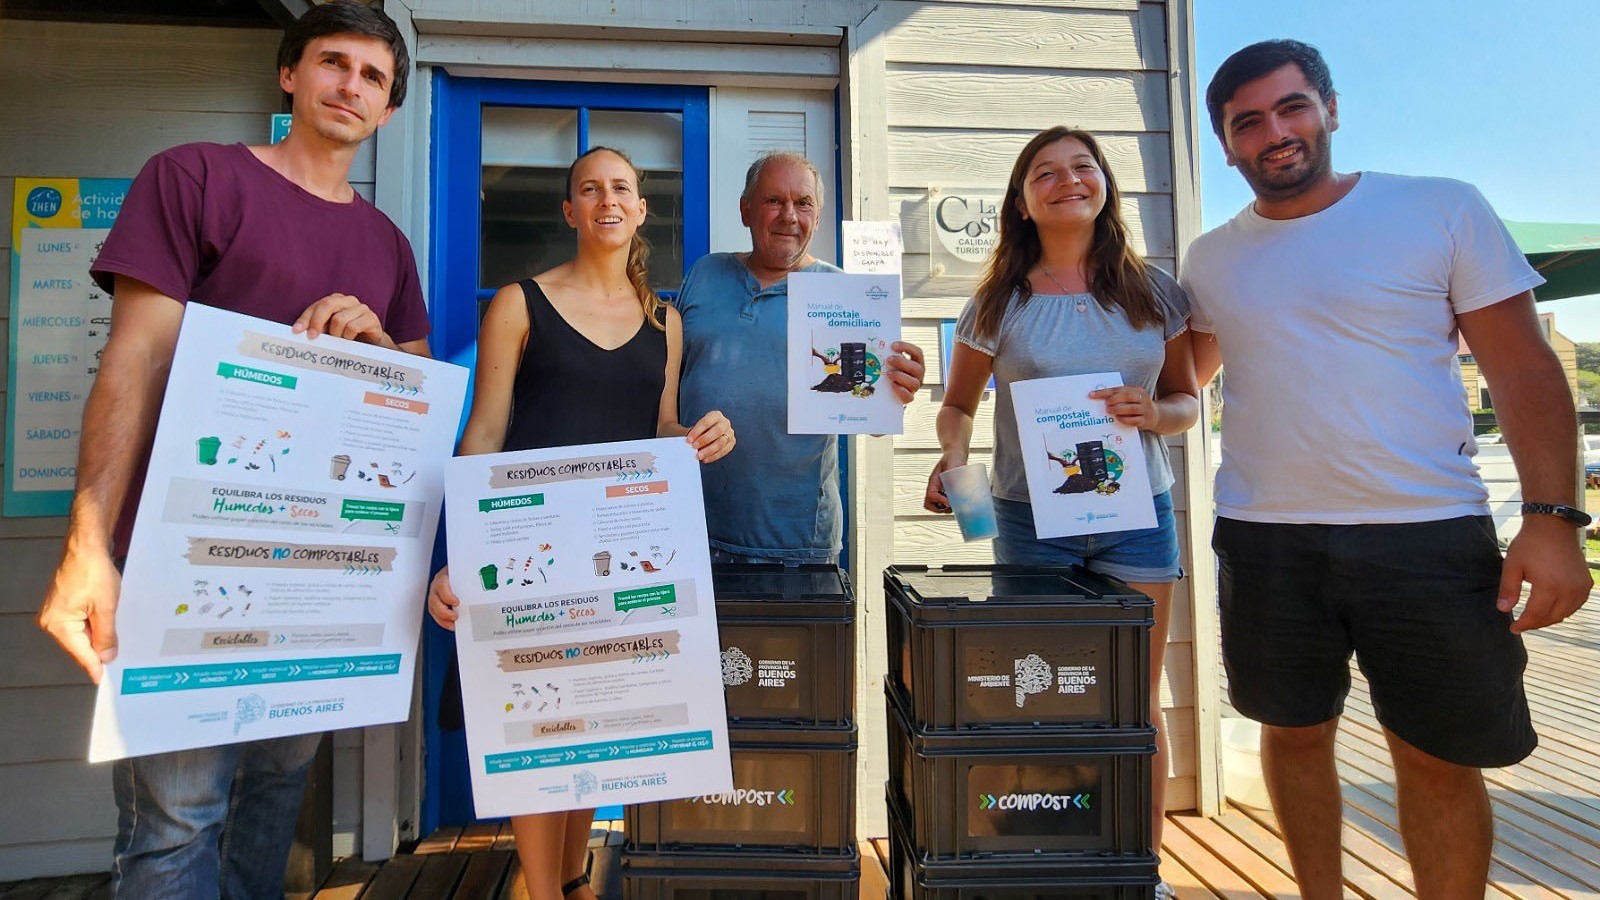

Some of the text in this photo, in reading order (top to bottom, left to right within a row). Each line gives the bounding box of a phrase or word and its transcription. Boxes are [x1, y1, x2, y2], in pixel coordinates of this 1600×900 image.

[73, 192, 125, 205] Activid
[32, 202, 57, 212] ZHEN
[979, 199, 996, 213] La
[72, 207, 119, 219] de ho
[936, 196, 1001, 237] Cost
[38, 243, 71, 252] LUNES
[955, 246, 993, 254] TURÍSTIC
[32, 280, 72, 289] MARTES
[807, 310, 860, 320] compostaje
[828, 318, 881, 328] domiciliario
[32, 355, 69, 364] JUEVES
[261, 341, 406, 382] RESIDUOS COMPOSTABLES
[233, 368, 282, 386] HÚMEDOS
[28, 391, 71, 402] VIERNES
[385, 398, 409, 409] SECOS
[1034, 406, 1062, 415] Manual
[1036, 410, 1090, 424] compostaje
[1059, 416, 1114, 430] domiciliario
[20, 468, 77, 478] DOMINGO
[506, 458, 636, 480] RESIDUOS COMPOSTABLES
[212, 487, 327, 504] EQUILIBRA LOS RESIDUOS
[625, 485, 649, 494] SECOS
[491, 496, 532, 509] HÚMEDOS
[290, 505, 320, 518] Secos
[208, 545, 379, 564] RESIDUOS NO COMPOSTABLES
[501, 596, 600, 614] EQUILIBRA LOS RESIDUOS
[506, 611, 556, 628] Humedos
[568, 607, 596, 620] Secos
[213, 635, 258, 646] Reciclables
[514, 637, 664, 664] RESIDUOS NO COMPOSTABLES
[758, 670, 796, 679] BUENOS
[1058, 676, 1096, 685] BUENOS
[758, 678, 786, 687] AIRES
[1058, 685, 1086, 694] AIRES
[269, 702, 344, 718] BUENOS AIRES
[541, 724, 576, 734] Reciclables
[602, 776, 668, 791] BUENOS AIRES
[703, 788, 775, 806] COMPOST
[998, 793, 1071, 811] COMPOST
